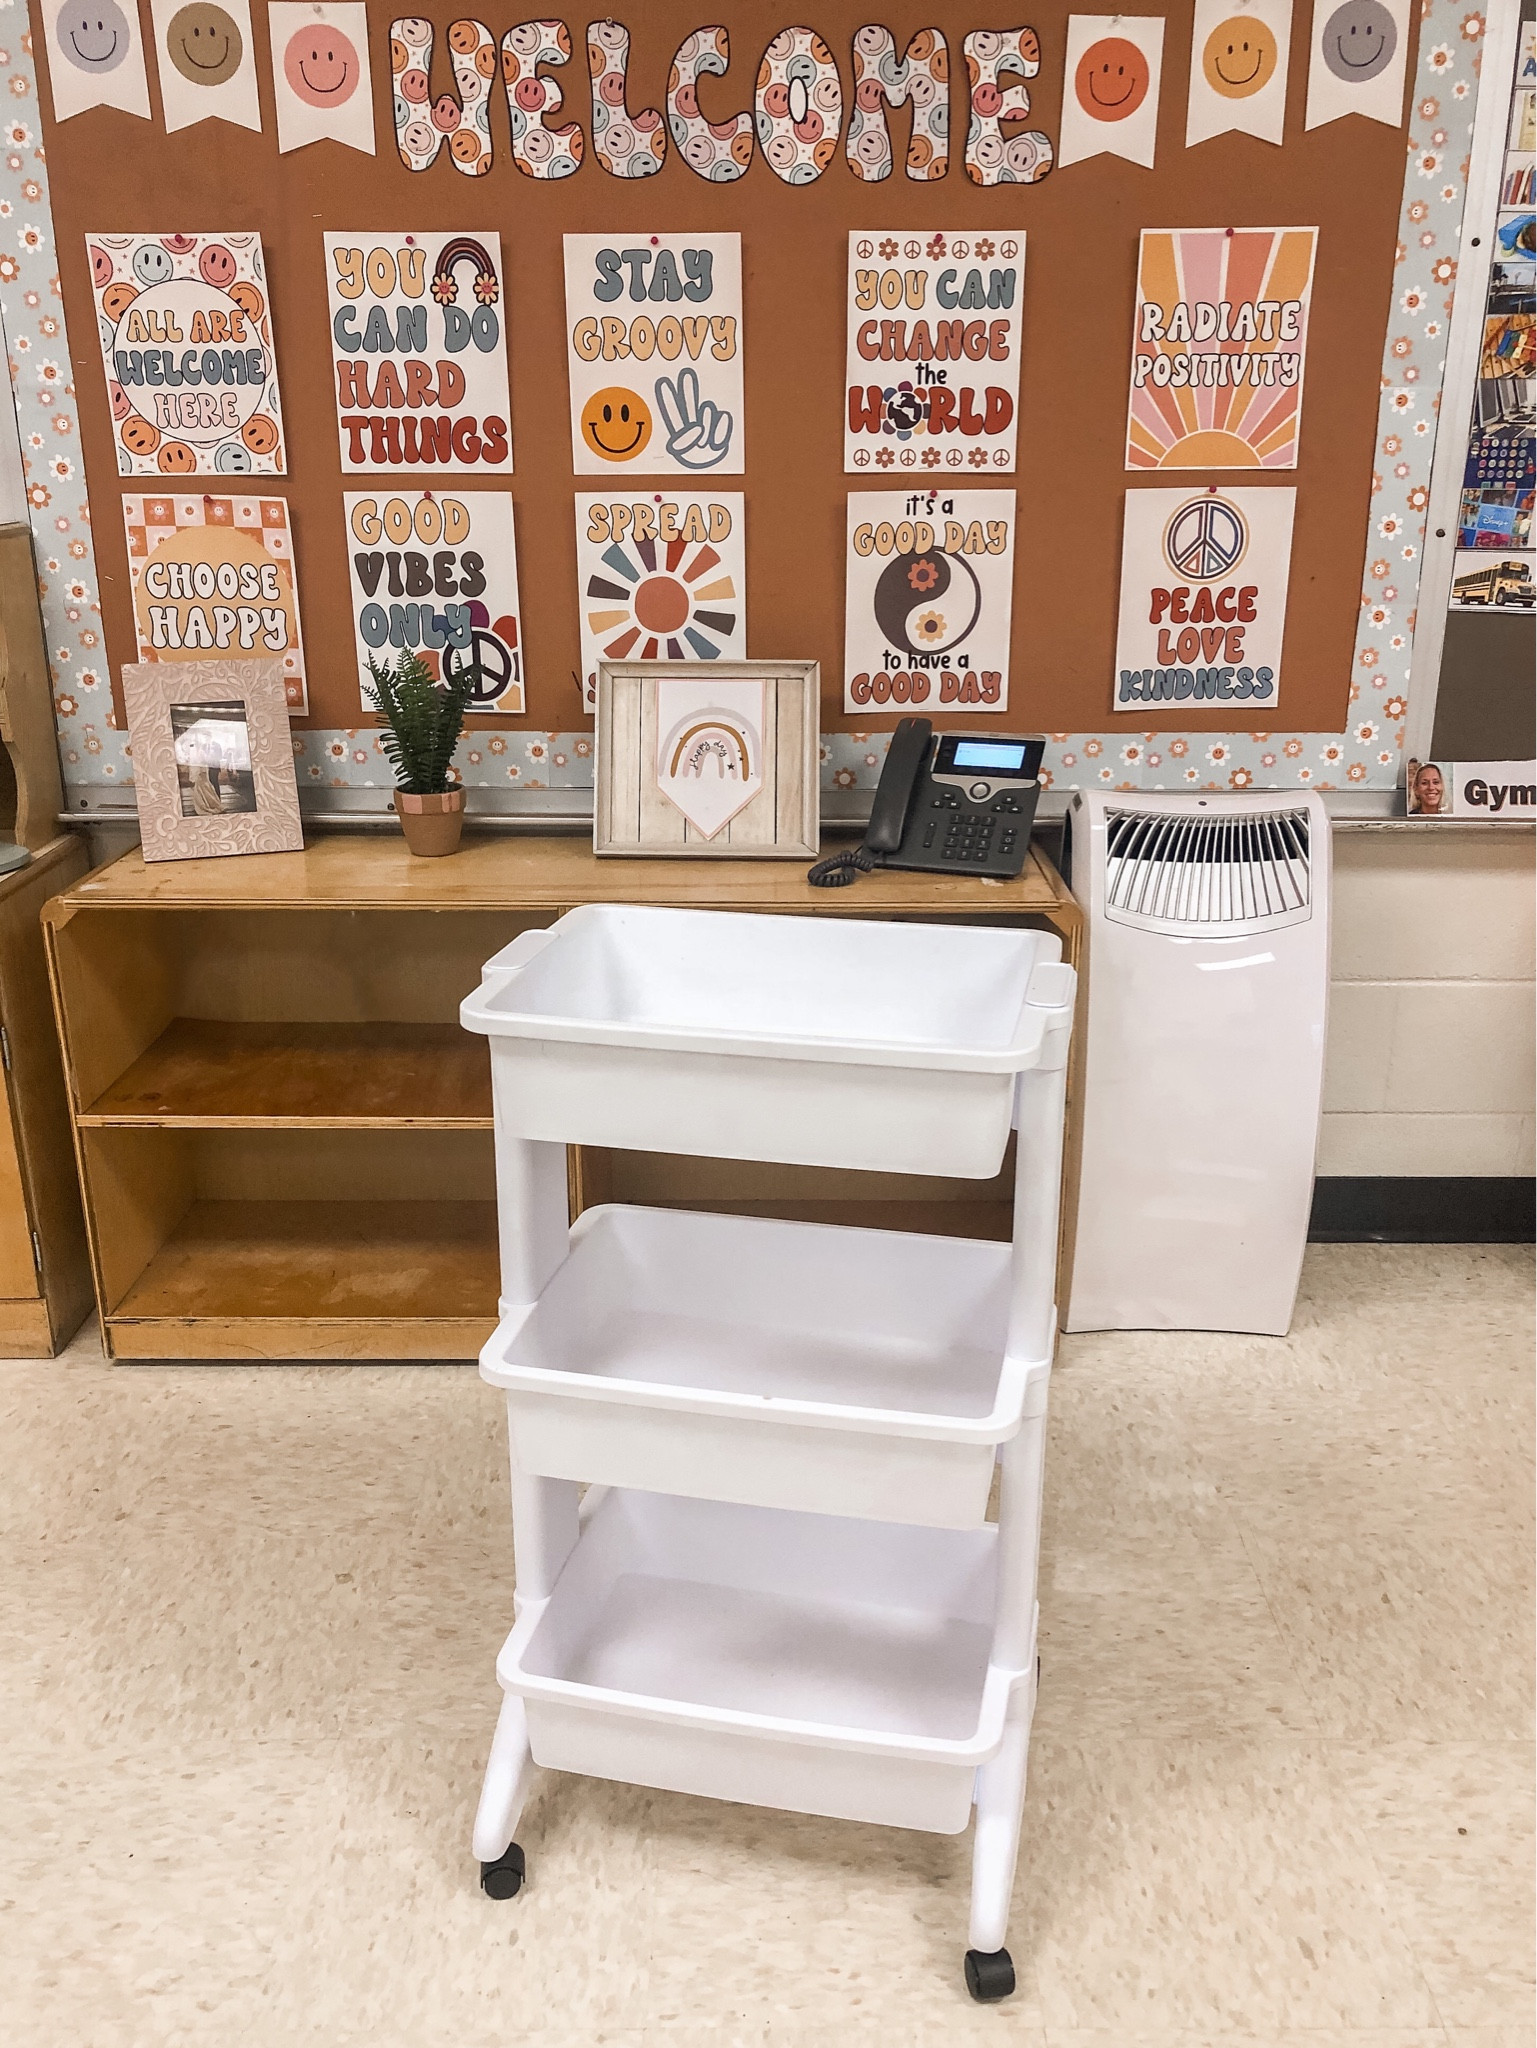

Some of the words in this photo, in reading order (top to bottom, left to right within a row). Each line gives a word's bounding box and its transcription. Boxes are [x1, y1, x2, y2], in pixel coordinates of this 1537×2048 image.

[388, 17, 1054, 186] WELCOME
[333, 246, 425, 299] YOU
[594, 248, 713, 303] STAY
[855, 268, 927, 311] YOU
[936, 268, 1015, 310] CAN
[126, 309, 183, 345] ALL
[190, 309, 247, 345] ARE
[333, 304, 429, 353] CAN
[443, 304, 500, 353] DO
[572, 316, 737, 363] GROOVY
[856, 319, 1011, 362] CHANGE
[1139, 300, 1302, 345] RADIATE
[115, 348, 266, 388] WELCOME
[336, 359, 467, 410] HARD
[915, 361, 948, 387] the
[1133, 352, 1301, 389] POSITIVITY
[154, 392, 240, 430] HERE
[340, 415, 508, 466] THINGS
[351, 498, 471, 547] GOOD
[587, 504, 732, 543] SPREAD
[905, 495, 935, 518] it's
[942, 501, 954, 517] a
[853, 521, 935, 558] GOOD
[944, 520, 1008, 556] DAY
[144, 562, 281, 601] CHOOSE
[354, 550, 487, 599] VIBES
[1149, 586, 1260, 625] PEACE
[151, 606, 287, 650] HAPPY
[360, 602, 473, 650] ONLY
[882, 650, 900, 672] to
[907, 650, 952, 672] have
[958, 655, 970, 671] a
[1156, 627, 1247, 666] LOVE
[849, 671, 933, 706] GOOD
[939, 671, 1003, 705] DAY
[1118, 667, 1275, 703] KINDNESS
[1464, 778, 1536, 812] Gym
